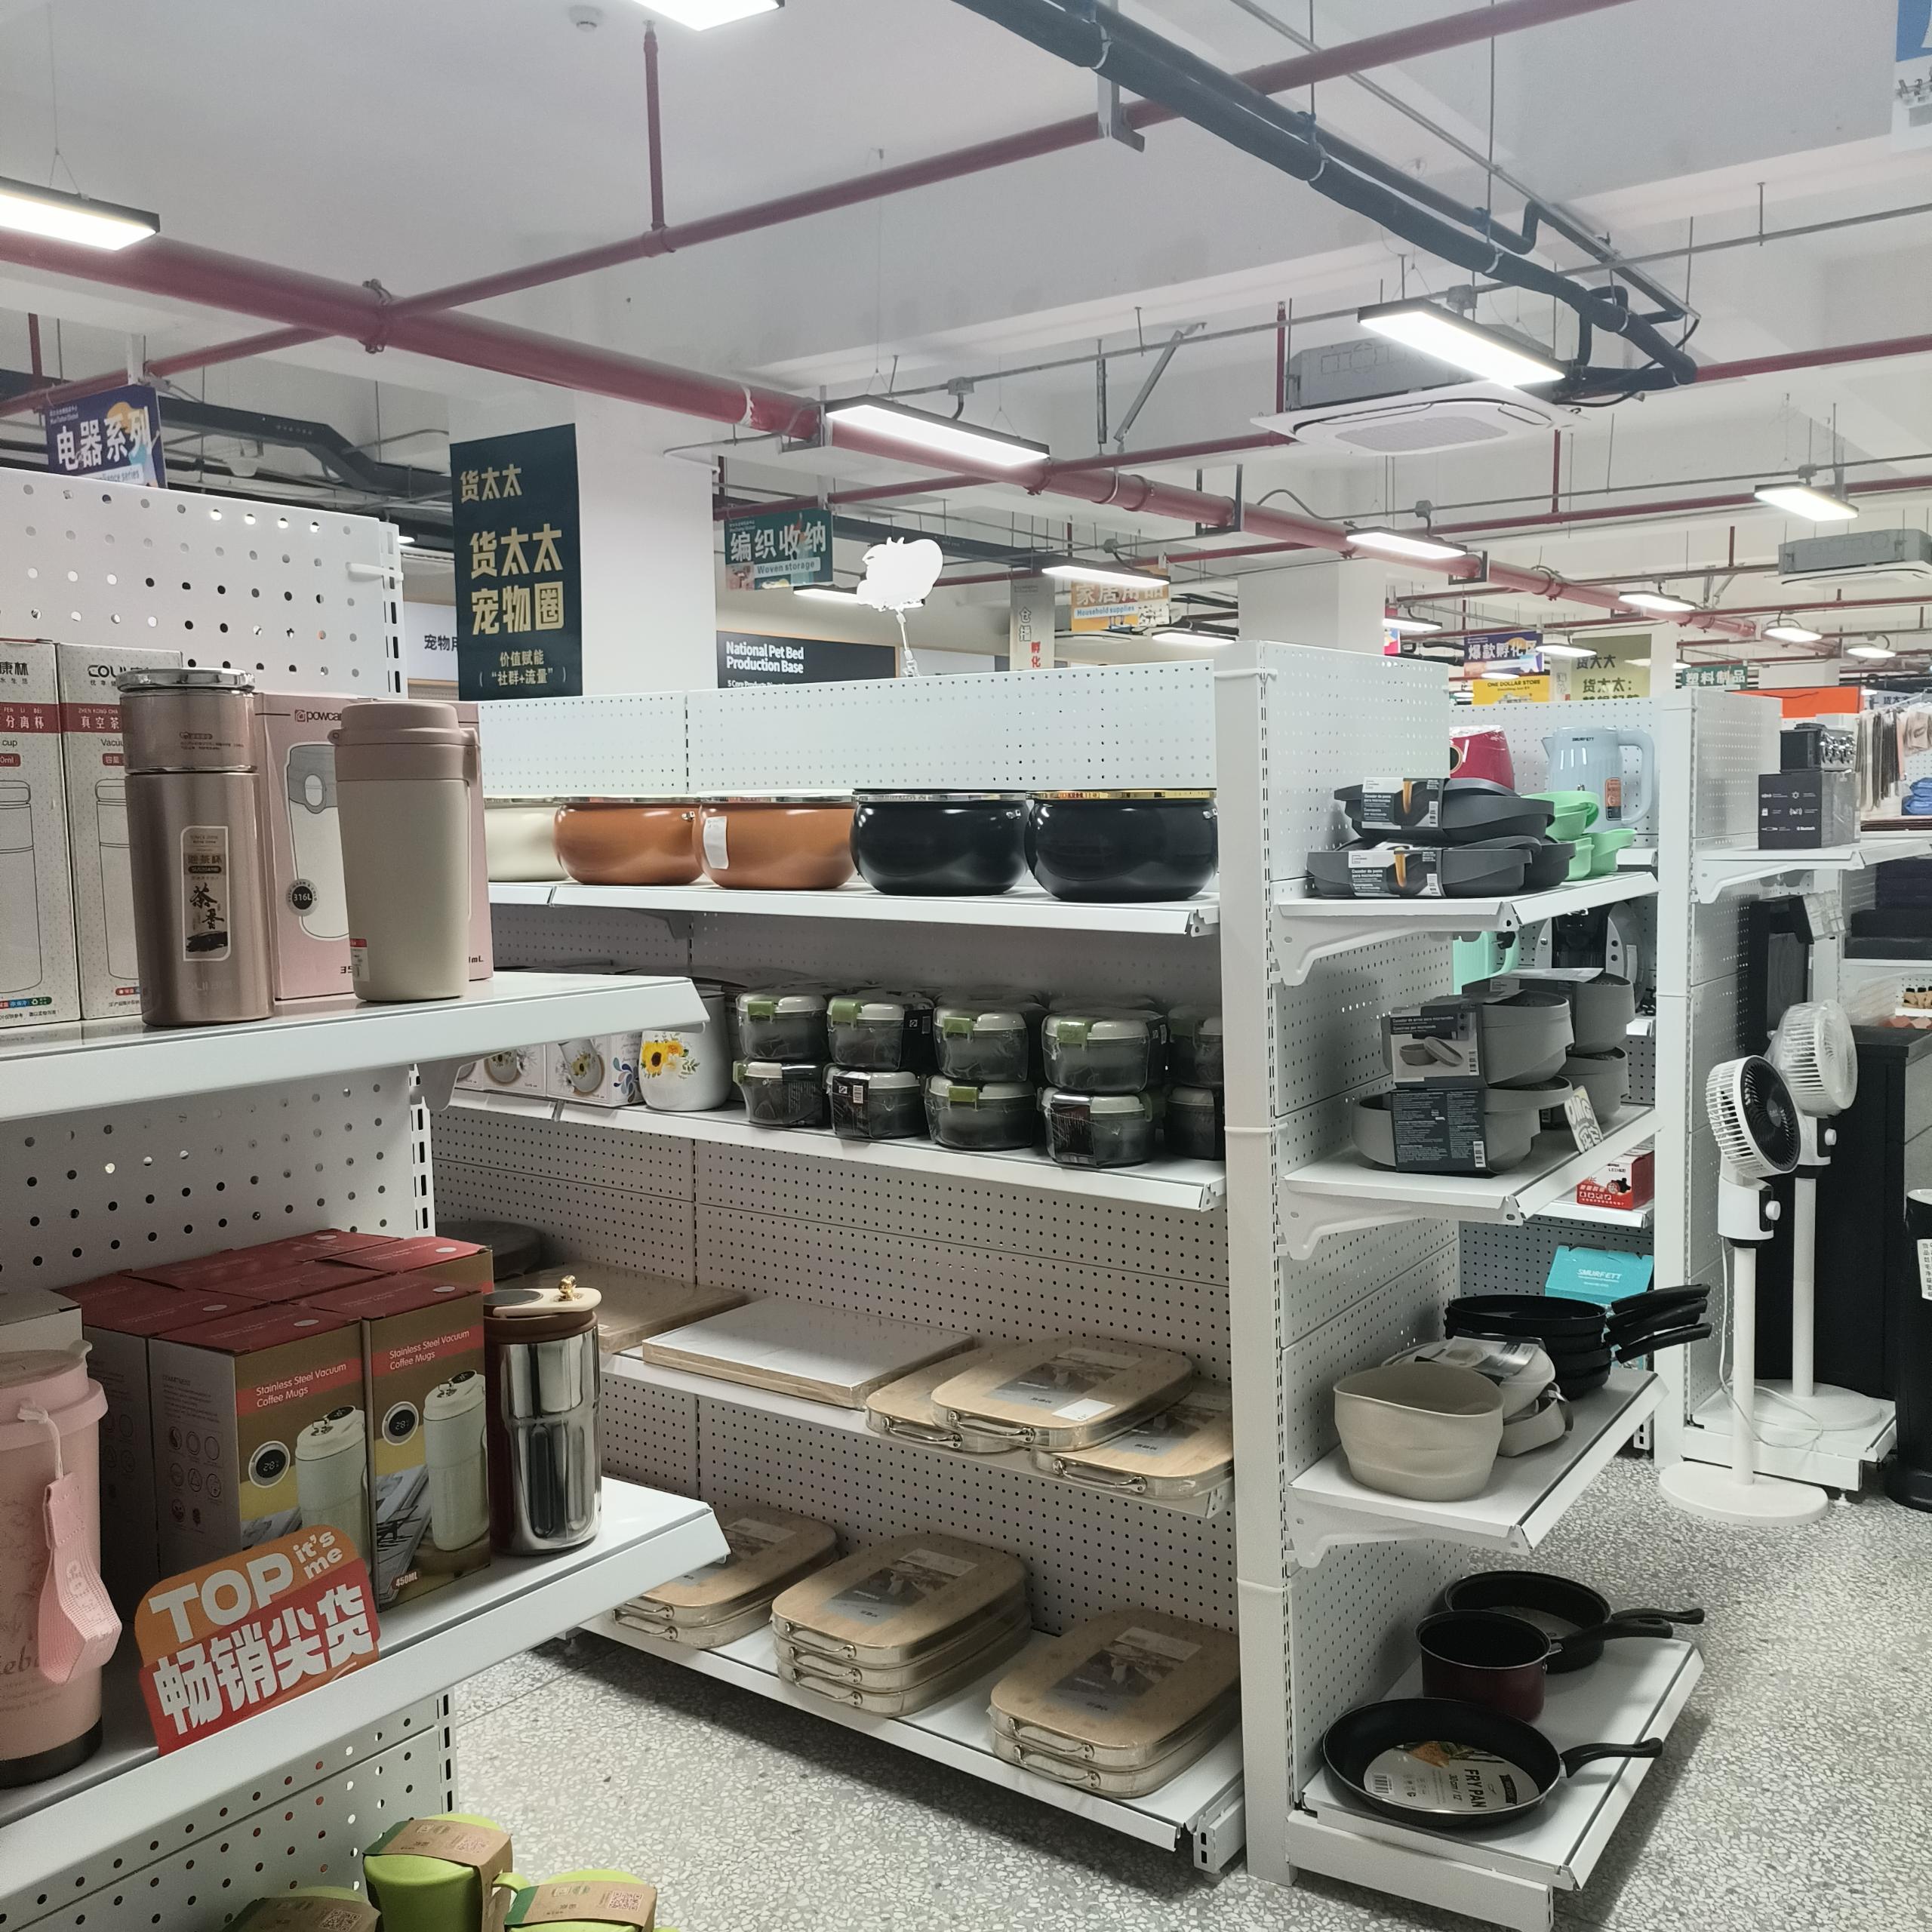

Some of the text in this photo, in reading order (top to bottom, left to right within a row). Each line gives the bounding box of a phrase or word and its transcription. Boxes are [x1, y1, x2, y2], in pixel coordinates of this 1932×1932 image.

[57, 405, 152, 471] 电器系列
[122, 469, 140, 481] series
[460, 463, 522, 503] 货太太
[731, 521, 826, 561] 编织收纳
[469, 523, 563, 580] 货太太
[758, 560, 815, 574] Woven storage
[471, 581, 565, 635] 宠物圈
[1077, 605, 1135, 617] Household supplies
[500, 649, 544, 667] 价值赋能
[726, 641, 804, 660] National Pet Bed
[1468, 640, 1537, 660] 爆款孵化区
[726, 656, 804, 673] Production Base
[1685, 669, 1745, 685] 塑料制品
[6, 715, 45, 729] 分离杯
[81, 715, 120, 730] 真空茶
[294, 893, 312, 901] 316L
[469, 955, 484, 963] mL
[1564, 1095, 1595, 1125] OMG
[389, 1331, 469, 1359] Stainless Steel Vacuum
[389, 1351, 435, 1371] Coffee Mugs
[257, 1364, 346, 1396] Stainless Steel Vacuum
[257, 1386, 309, 1407] Coffee Mugs
[303, 1548, 343, 1580] me
[148, 1552, 294, 1644] TOP
[293, 1531, 335, 1564] it's
[395, 1571, 417, 1587] 450ML
[152, 1583, 374, 1736] 畅销尖货
[1464, 1768, 1487, 1808] FRY PAN
